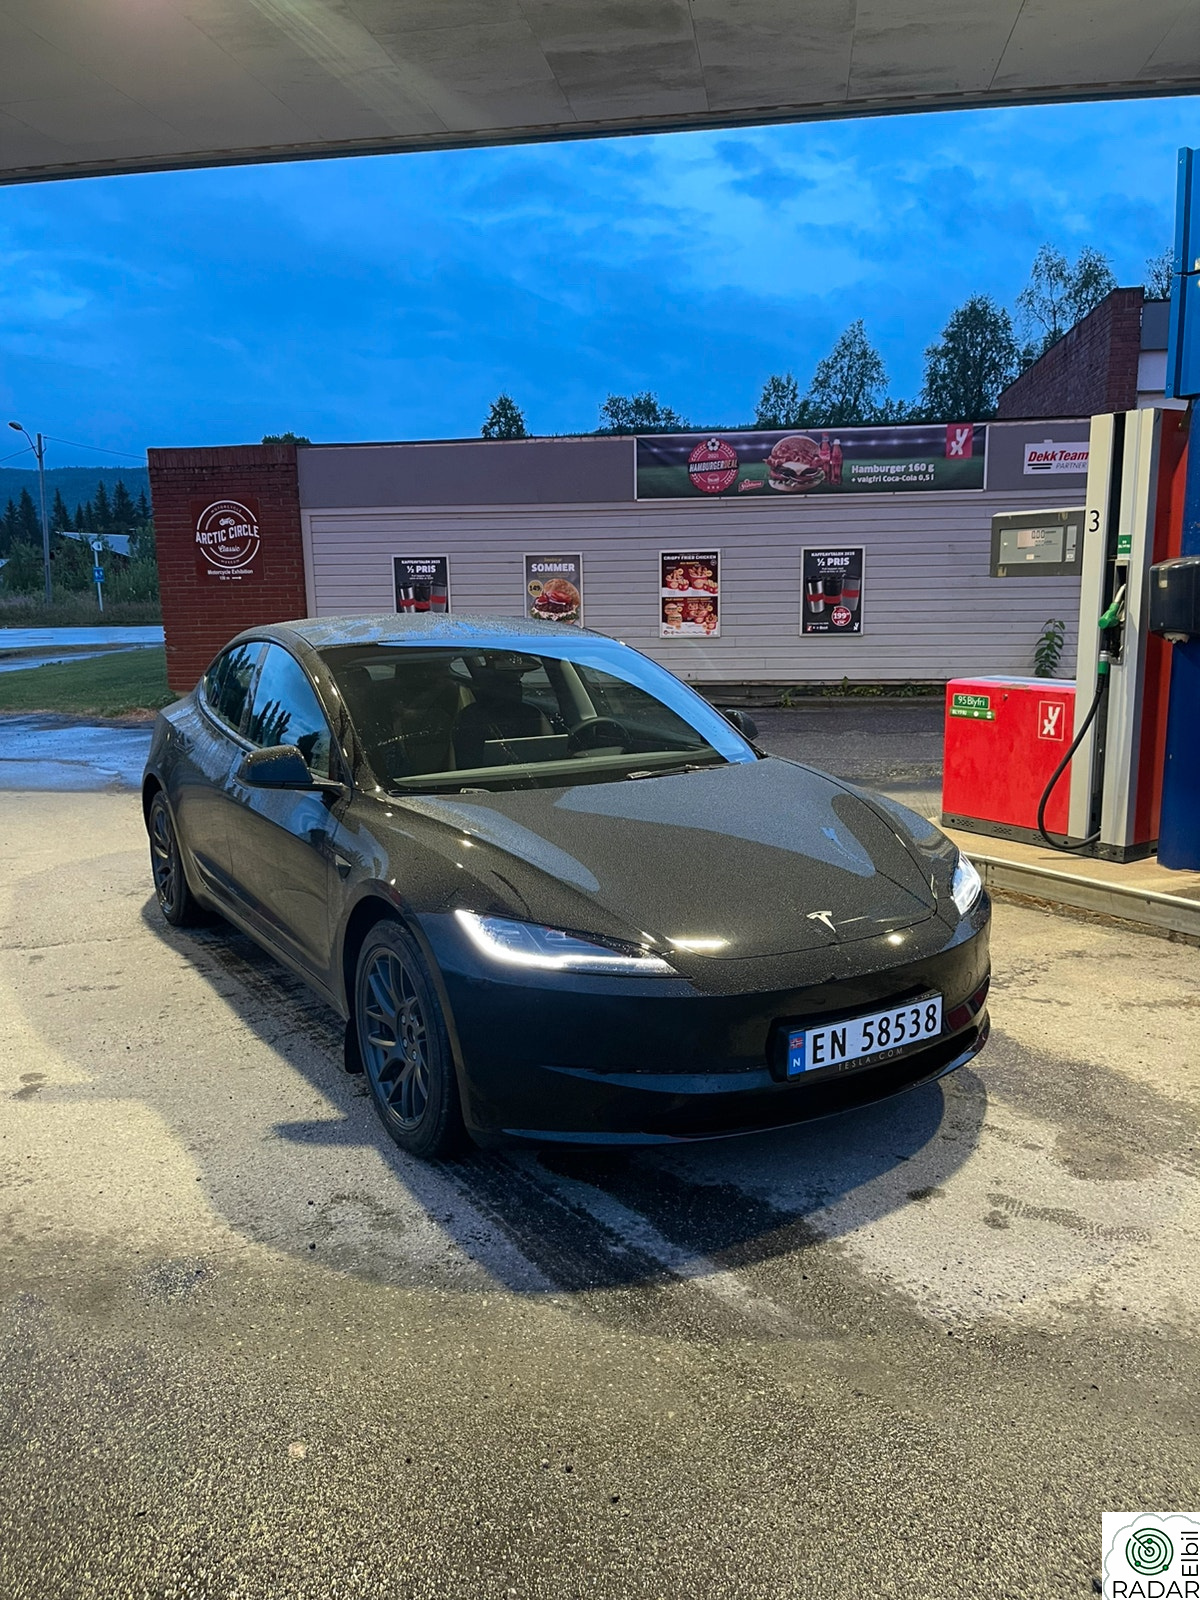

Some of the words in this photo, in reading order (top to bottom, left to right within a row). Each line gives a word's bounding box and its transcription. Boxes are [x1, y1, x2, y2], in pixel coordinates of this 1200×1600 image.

[851, 465, 906, 474] Hamburger
[908, 463, 926, 472] 160
[928, 463, 935, 473] g
[1056, 461, 1088, 469] PARTNER
[857, 475, 882, 484] valgfri
[882, 474, 918, 482] Coca-Cola
[918, 474, 930, 482] 0,5
[1088, 510, 1100, 532] 3
[195, 529, 227, 544] ARCTIC
[228, 524, 260, 539] CIRCLE
[827, 557, 850, 566] PRIS
[416, 564, 436, 573] PRIS
[531, 563, 575, 572] SOMMER
[957, 695, 967, 705] 95
[967, 696, 985, 707] Blyfri
[812, 1028, 847, 1065] EN
[861, 1003, 937, 1052] 58538
[792, 1057, 801, 1068] N
[838, 1047, 904, 1072] TESLA.COM
